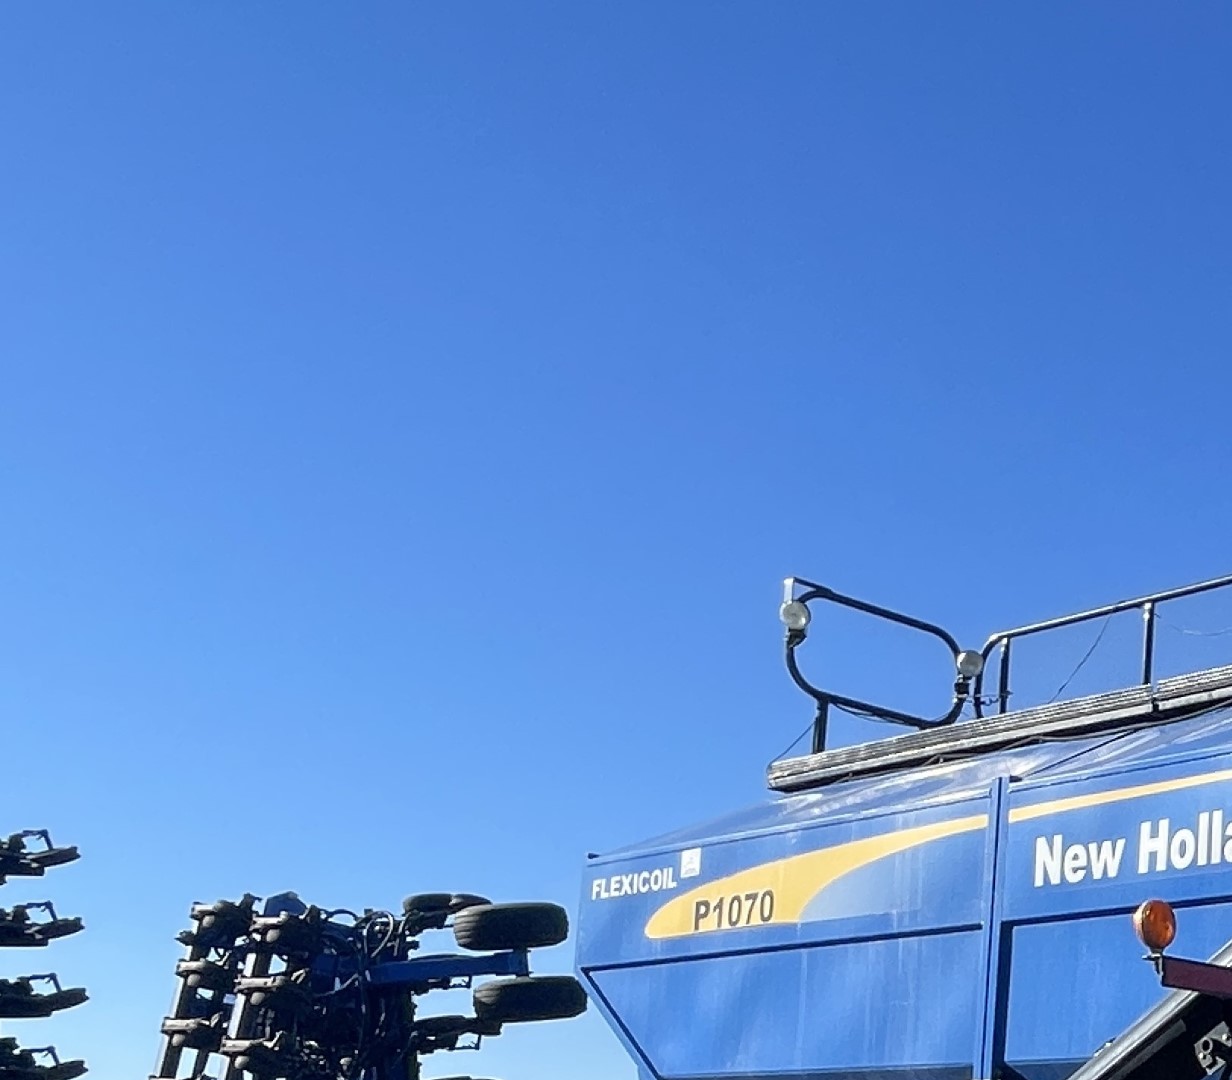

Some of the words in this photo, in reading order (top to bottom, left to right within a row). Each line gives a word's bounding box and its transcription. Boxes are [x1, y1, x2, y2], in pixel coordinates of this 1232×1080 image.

[1033, 834, 1126, 888] New
[591, 867, 678, 900] FLEXICOIL
[694, 889, 774, 931] P1070
